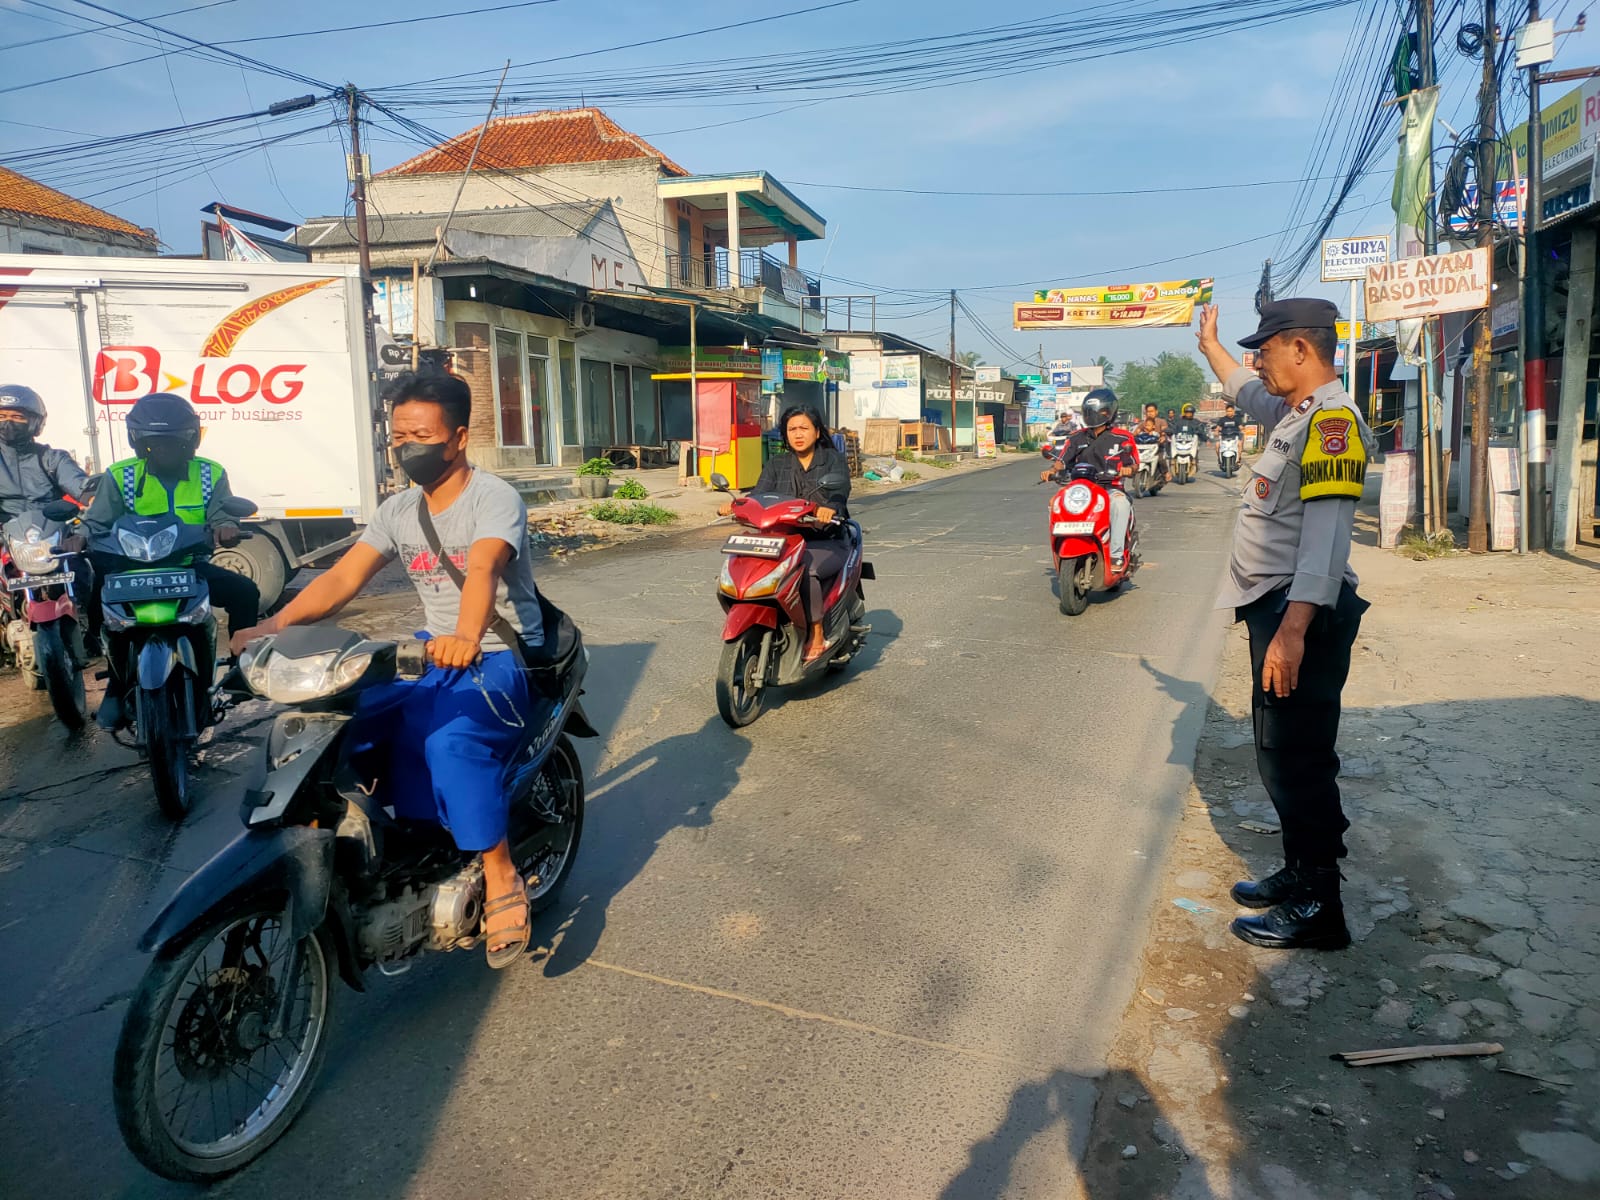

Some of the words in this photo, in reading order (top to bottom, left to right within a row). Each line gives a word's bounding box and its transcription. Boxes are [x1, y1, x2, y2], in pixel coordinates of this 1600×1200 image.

[1544, 139, 1588, 170] ELECTRONIC
[1341, 241, 1386, 255] SURYA
[1325, 256, 1386, 267] ELECTRONIC
[1369, 263, 1408, 283] MIE
[1415, 253, 1473, 277] AYAM
[1368, 281, 1415, 304] BASO
[1419, 274, 1484, 297] RUDAL
[1067, 294, 1098, 303] NANAS
[1050, 362, 1071, 370] Mobil
[190, 363, 307, 404] LOG
[926, 389, 975, 400] PUTRA
[979, 390, 1006, 402] IBU
[232, 408, 303, 421] business
[1271, 438, 1291, 454] POLRI
